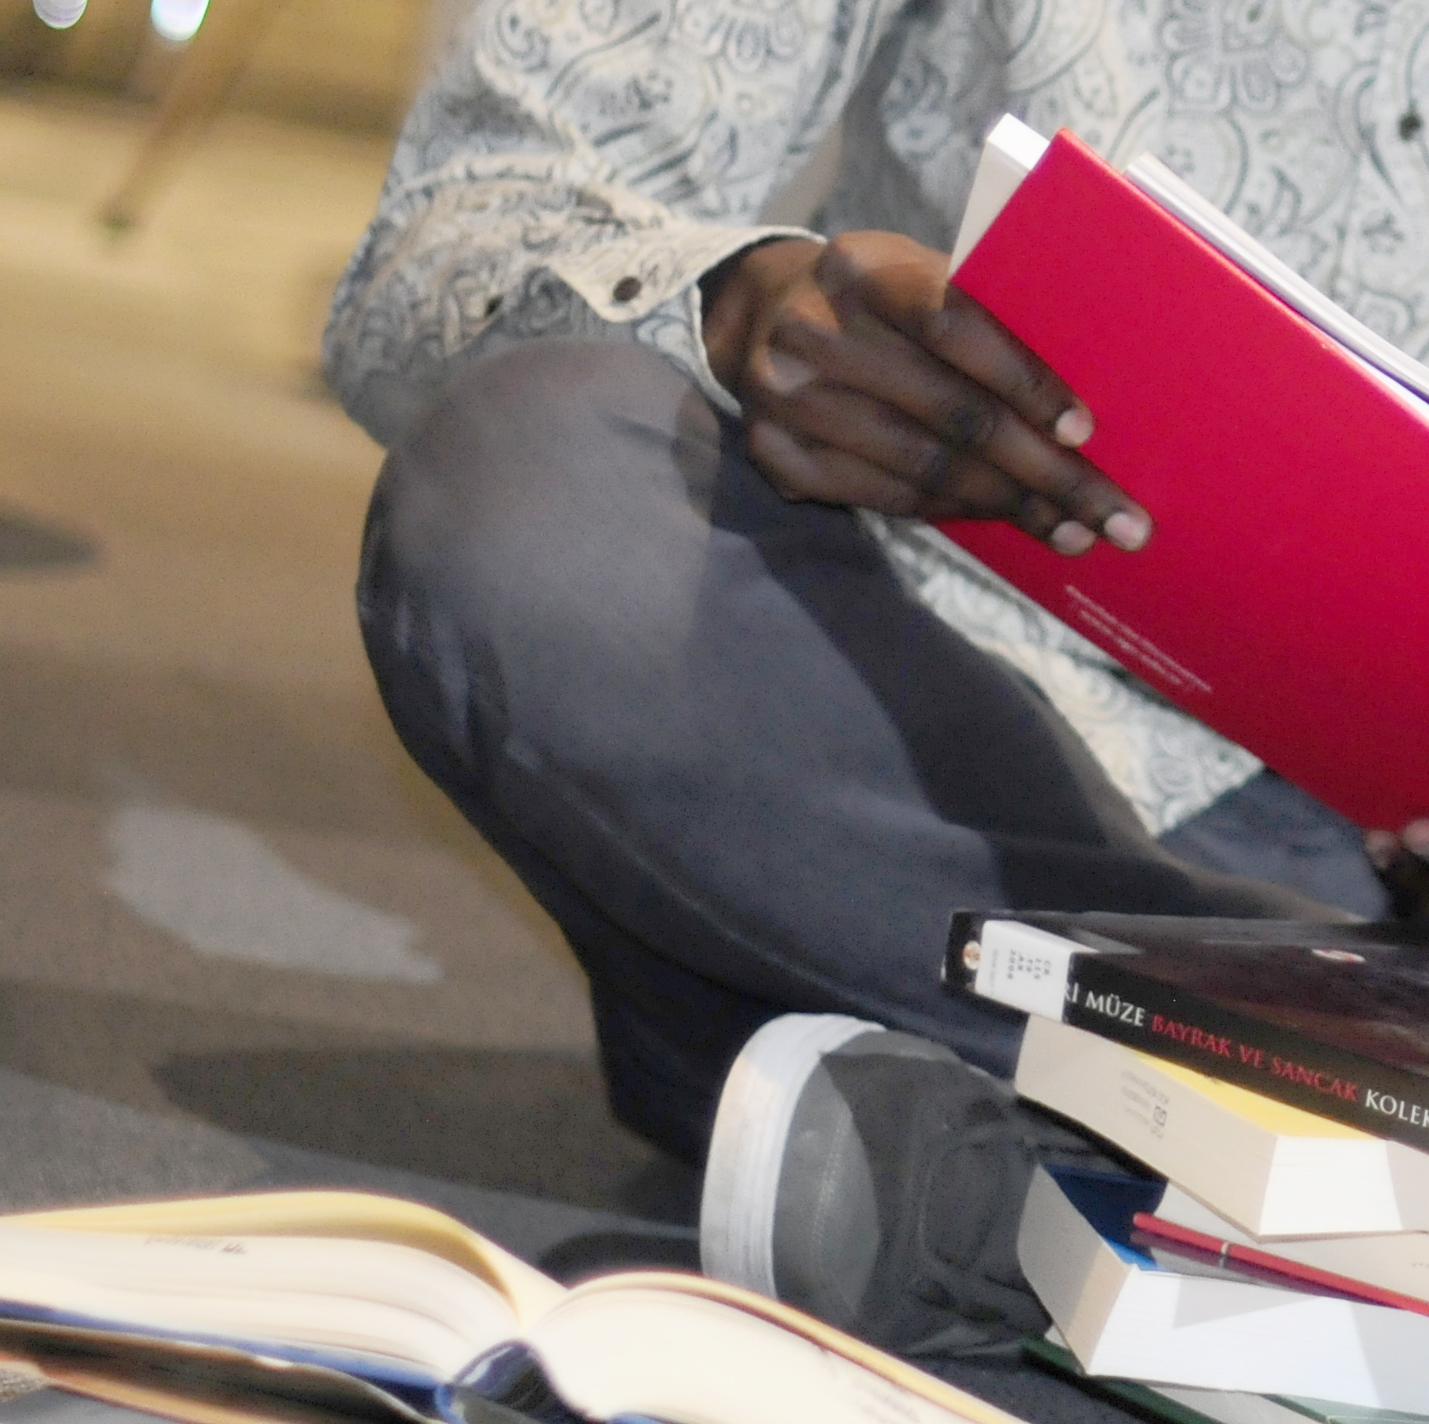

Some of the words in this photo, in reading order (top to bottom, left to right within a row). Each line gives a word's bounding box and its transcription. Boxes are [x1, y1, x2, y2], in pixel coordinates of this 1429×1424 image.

[1085, 990, 1146, 1026] MÜZE
[1152, 1014, 1231, 1058] BAYRAK
[1239, 1044, 1265, 1069] VE
[1273, 1057, 1359, 1103] SANCAK
